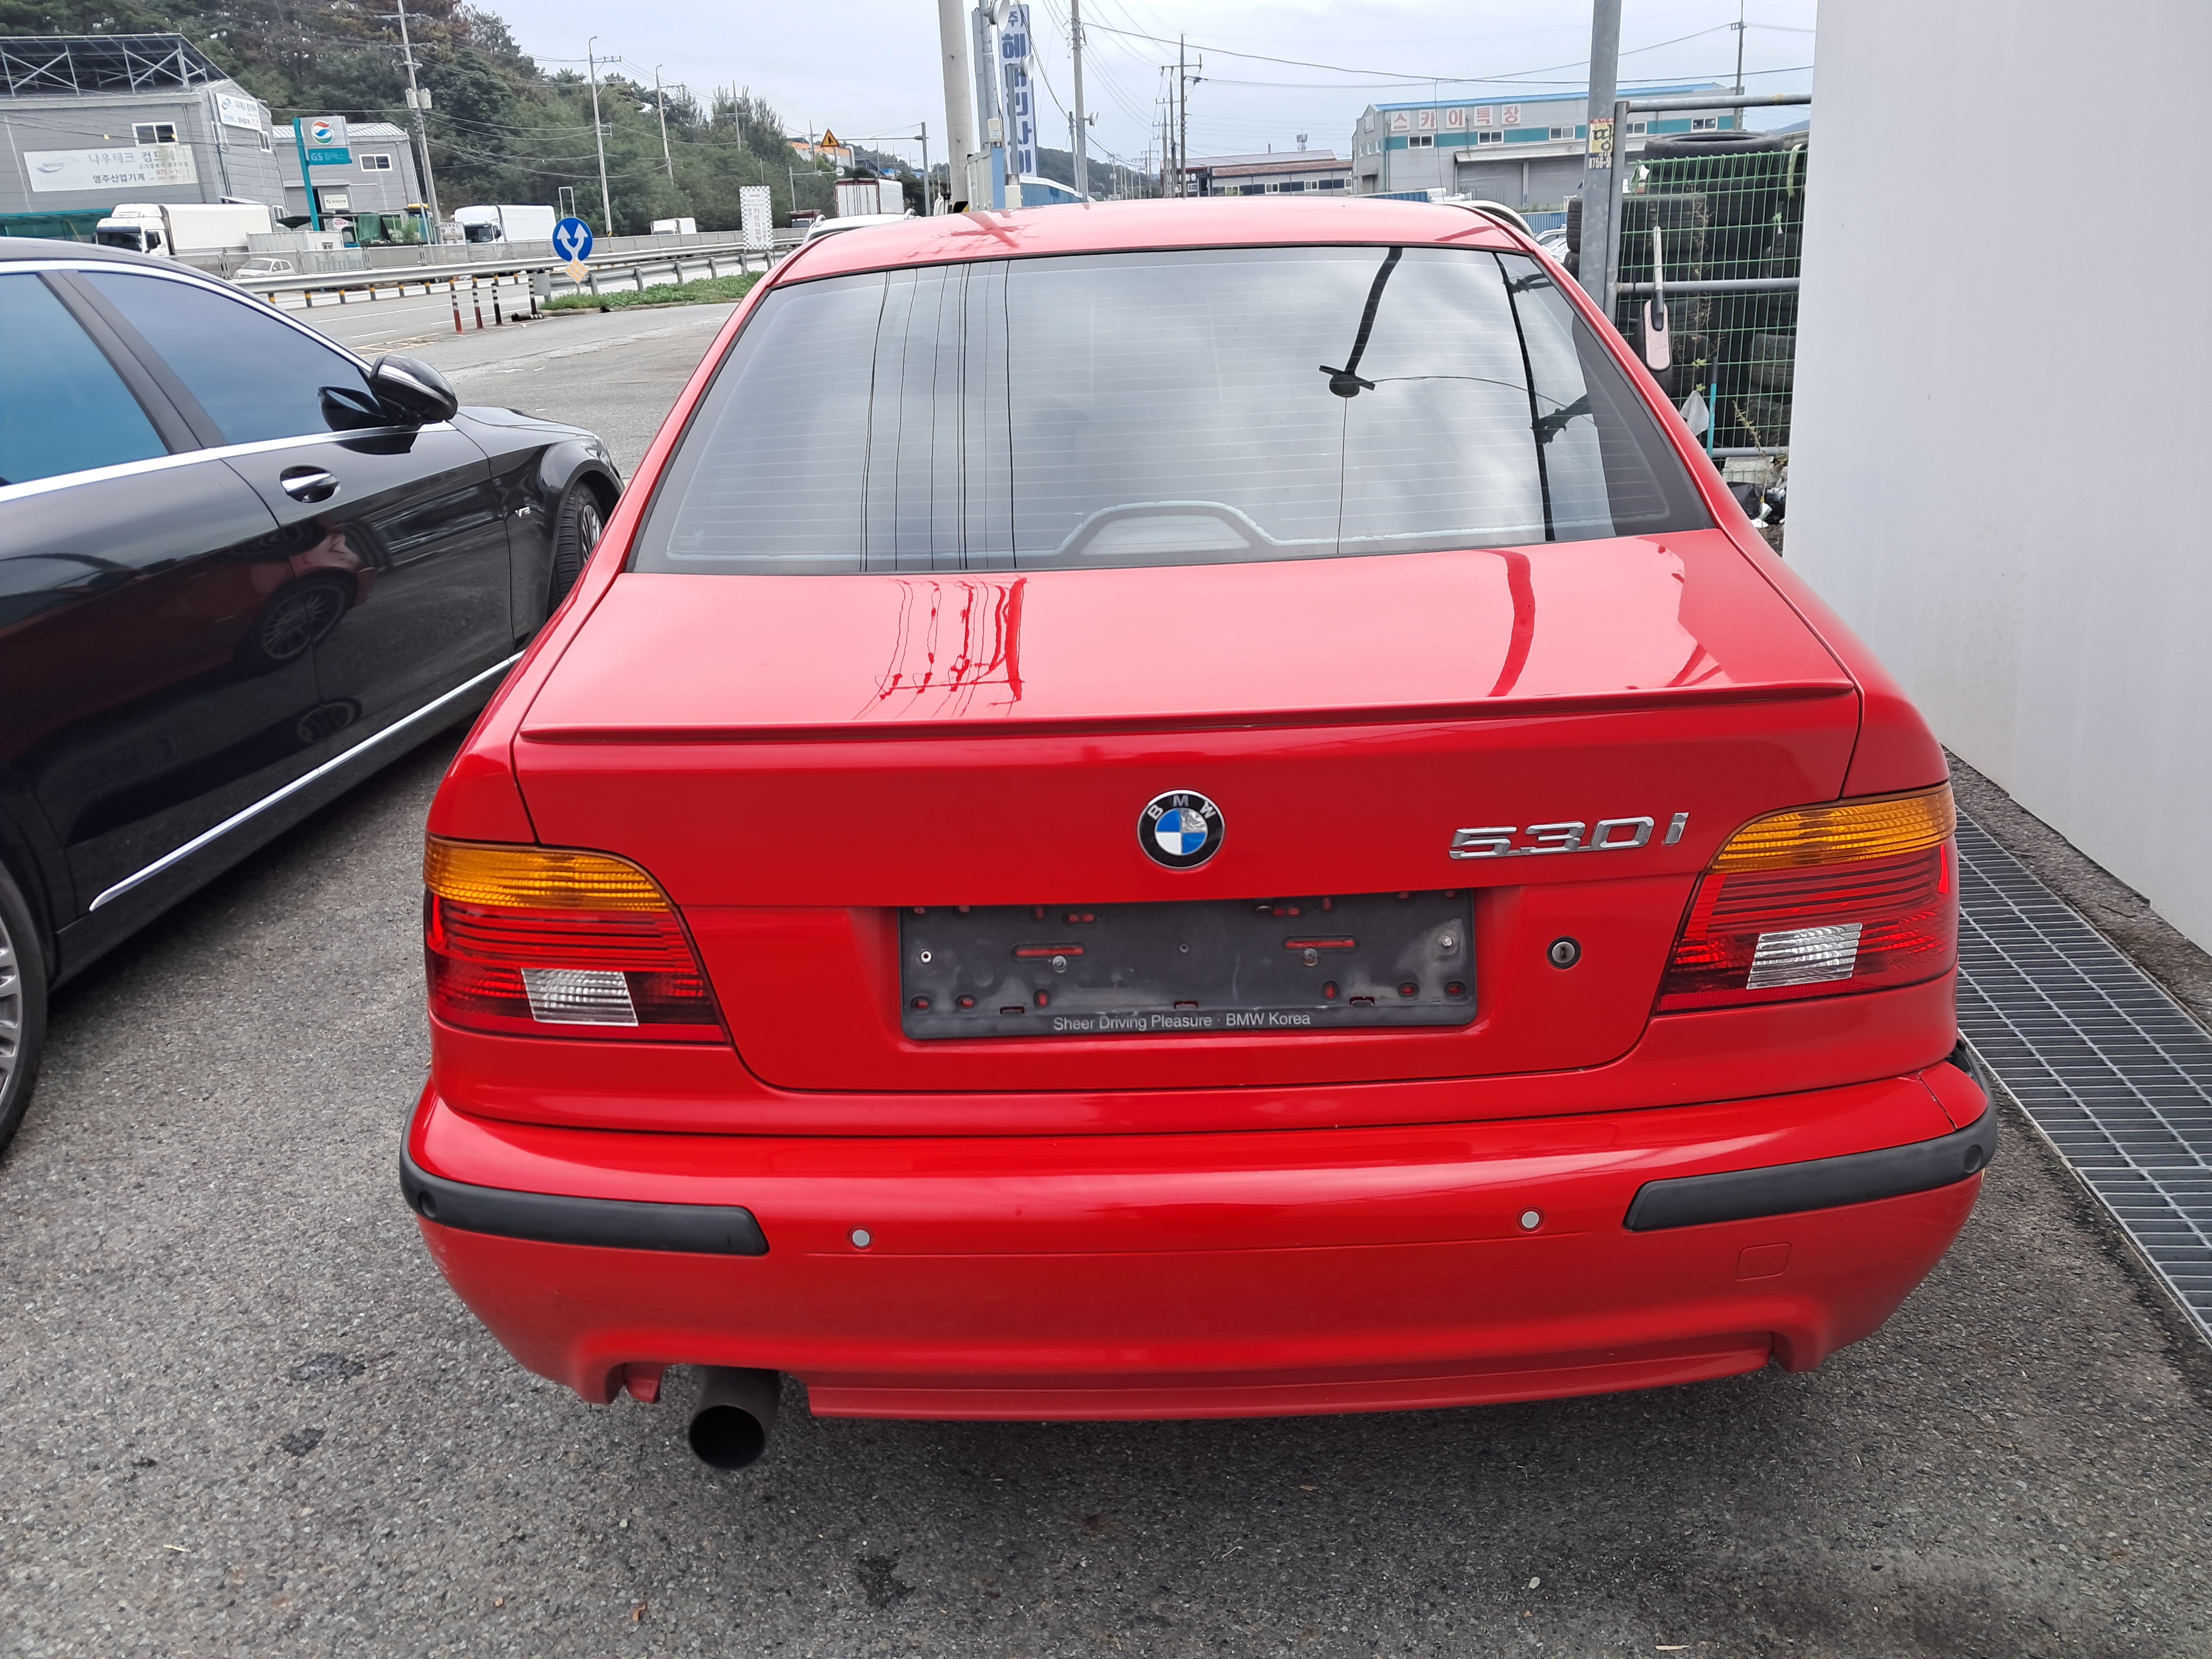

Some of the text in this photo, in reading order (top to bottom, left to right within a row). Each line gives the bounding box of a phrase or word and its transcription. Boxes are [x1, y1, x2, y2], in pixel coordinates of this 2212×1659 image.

[1393, 105, 1519, 129] 스카이특장
[1592, 124, 1613, 151] 땅
[88, 152, 135, 164] 나우테크
[93, 172, 145, 184] 영주산업기계
[1147, 795, 1217, 820] BMW
[1449, 812, 1689, 859] 530i
[1053, 1012, 1311, 1031] Sheer Driving Pleasure BMW Korea
